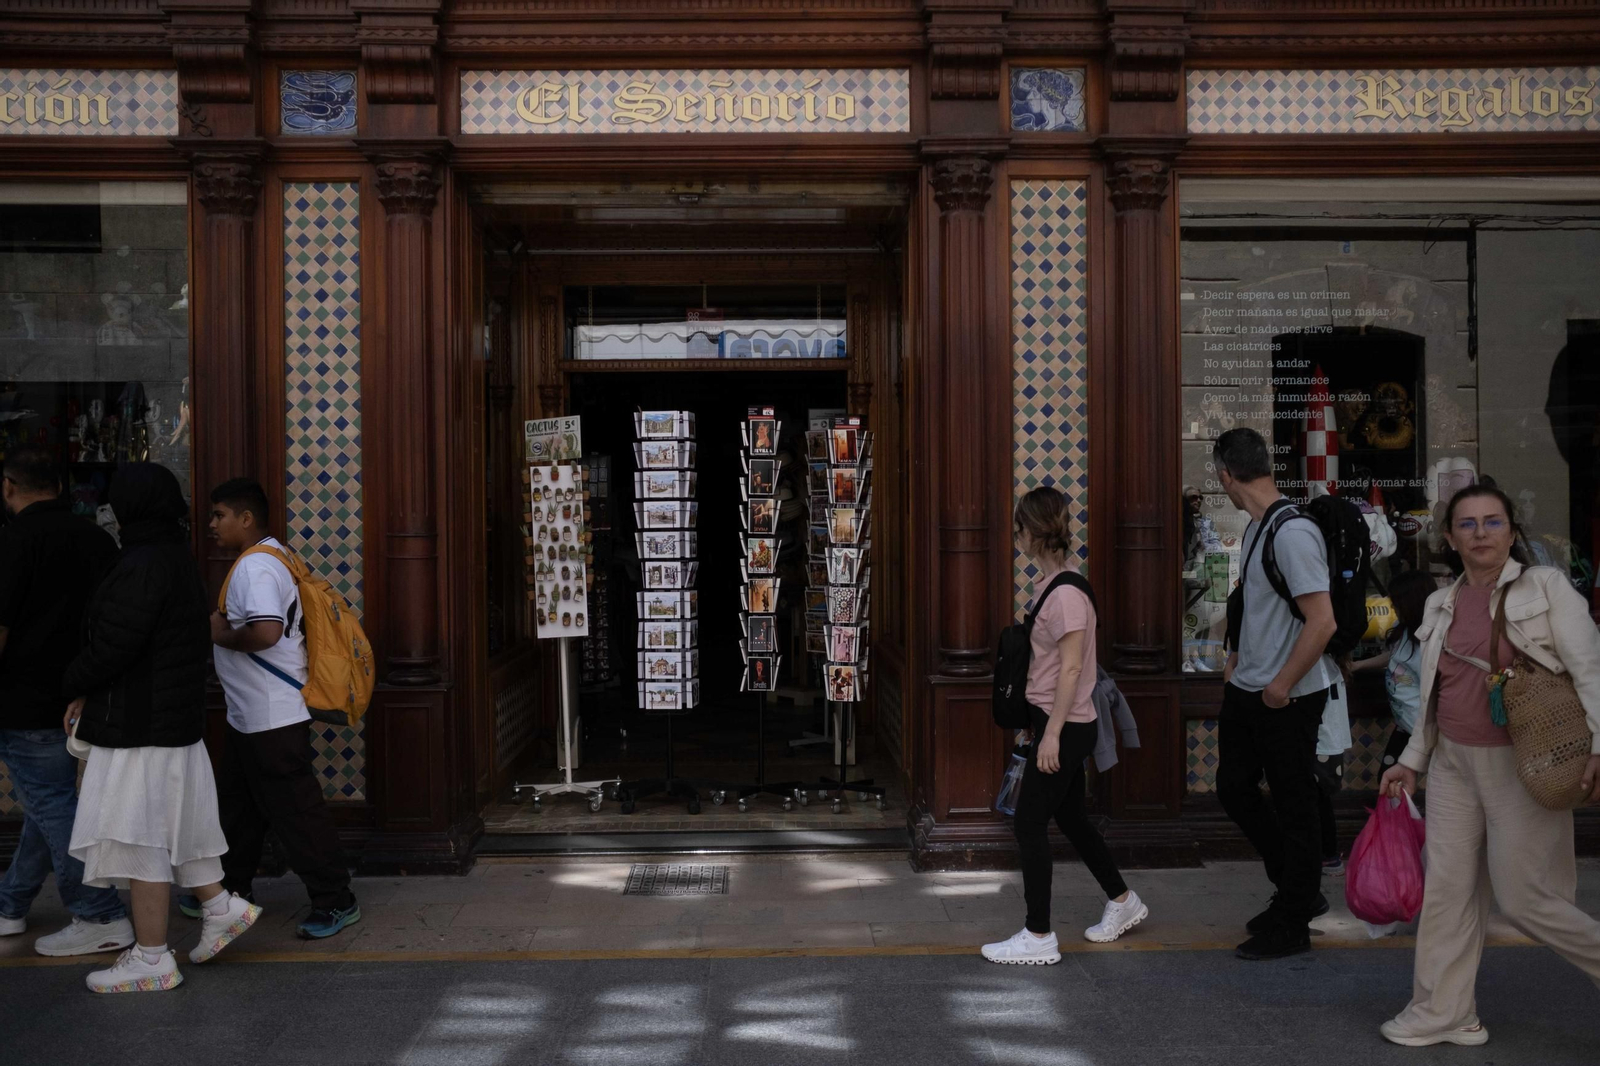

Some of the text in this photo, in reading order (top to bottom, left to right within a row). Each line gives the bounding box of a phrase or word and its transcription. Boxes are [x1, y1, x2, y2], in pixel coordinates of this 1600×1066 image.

[515, 78, 857, 125] El Señorío
[1353, 74, 1596, 128] Regalos
[1203, 289, 1351, 302] Decir espera es un crimen
[1203, 307, 1234, 317] Decir
[1236, 307, 1284, 317] mañana
[1285, 309, 1298, 317] es
[1300, 306, 1329, 319] igual
[1331, 309, 1352, 319] que
[1203, 324, 1333, 336] Ayer de nada nos sirve
[1203, 341, 1282, 351] Las cicatrices
[1203, 358, 1311, 370] No ayudan a andar
[1203, 375, 1330, 388] Sólo morir permanece
[1203, 391, 1371, 403] Como la más inmutable razón
[1203, 409, 1323, 419] Vivir es un accidente
[526, 419, 559, 434] CACTUS
[1205, 428, 1220, 437] Un
[1267, 445, 1292, 454] olor
[1335, 478, 1369, 489] puede
[1371, 477, 1407, 487] tomar
[1204, 496, 1226, 507] Que
